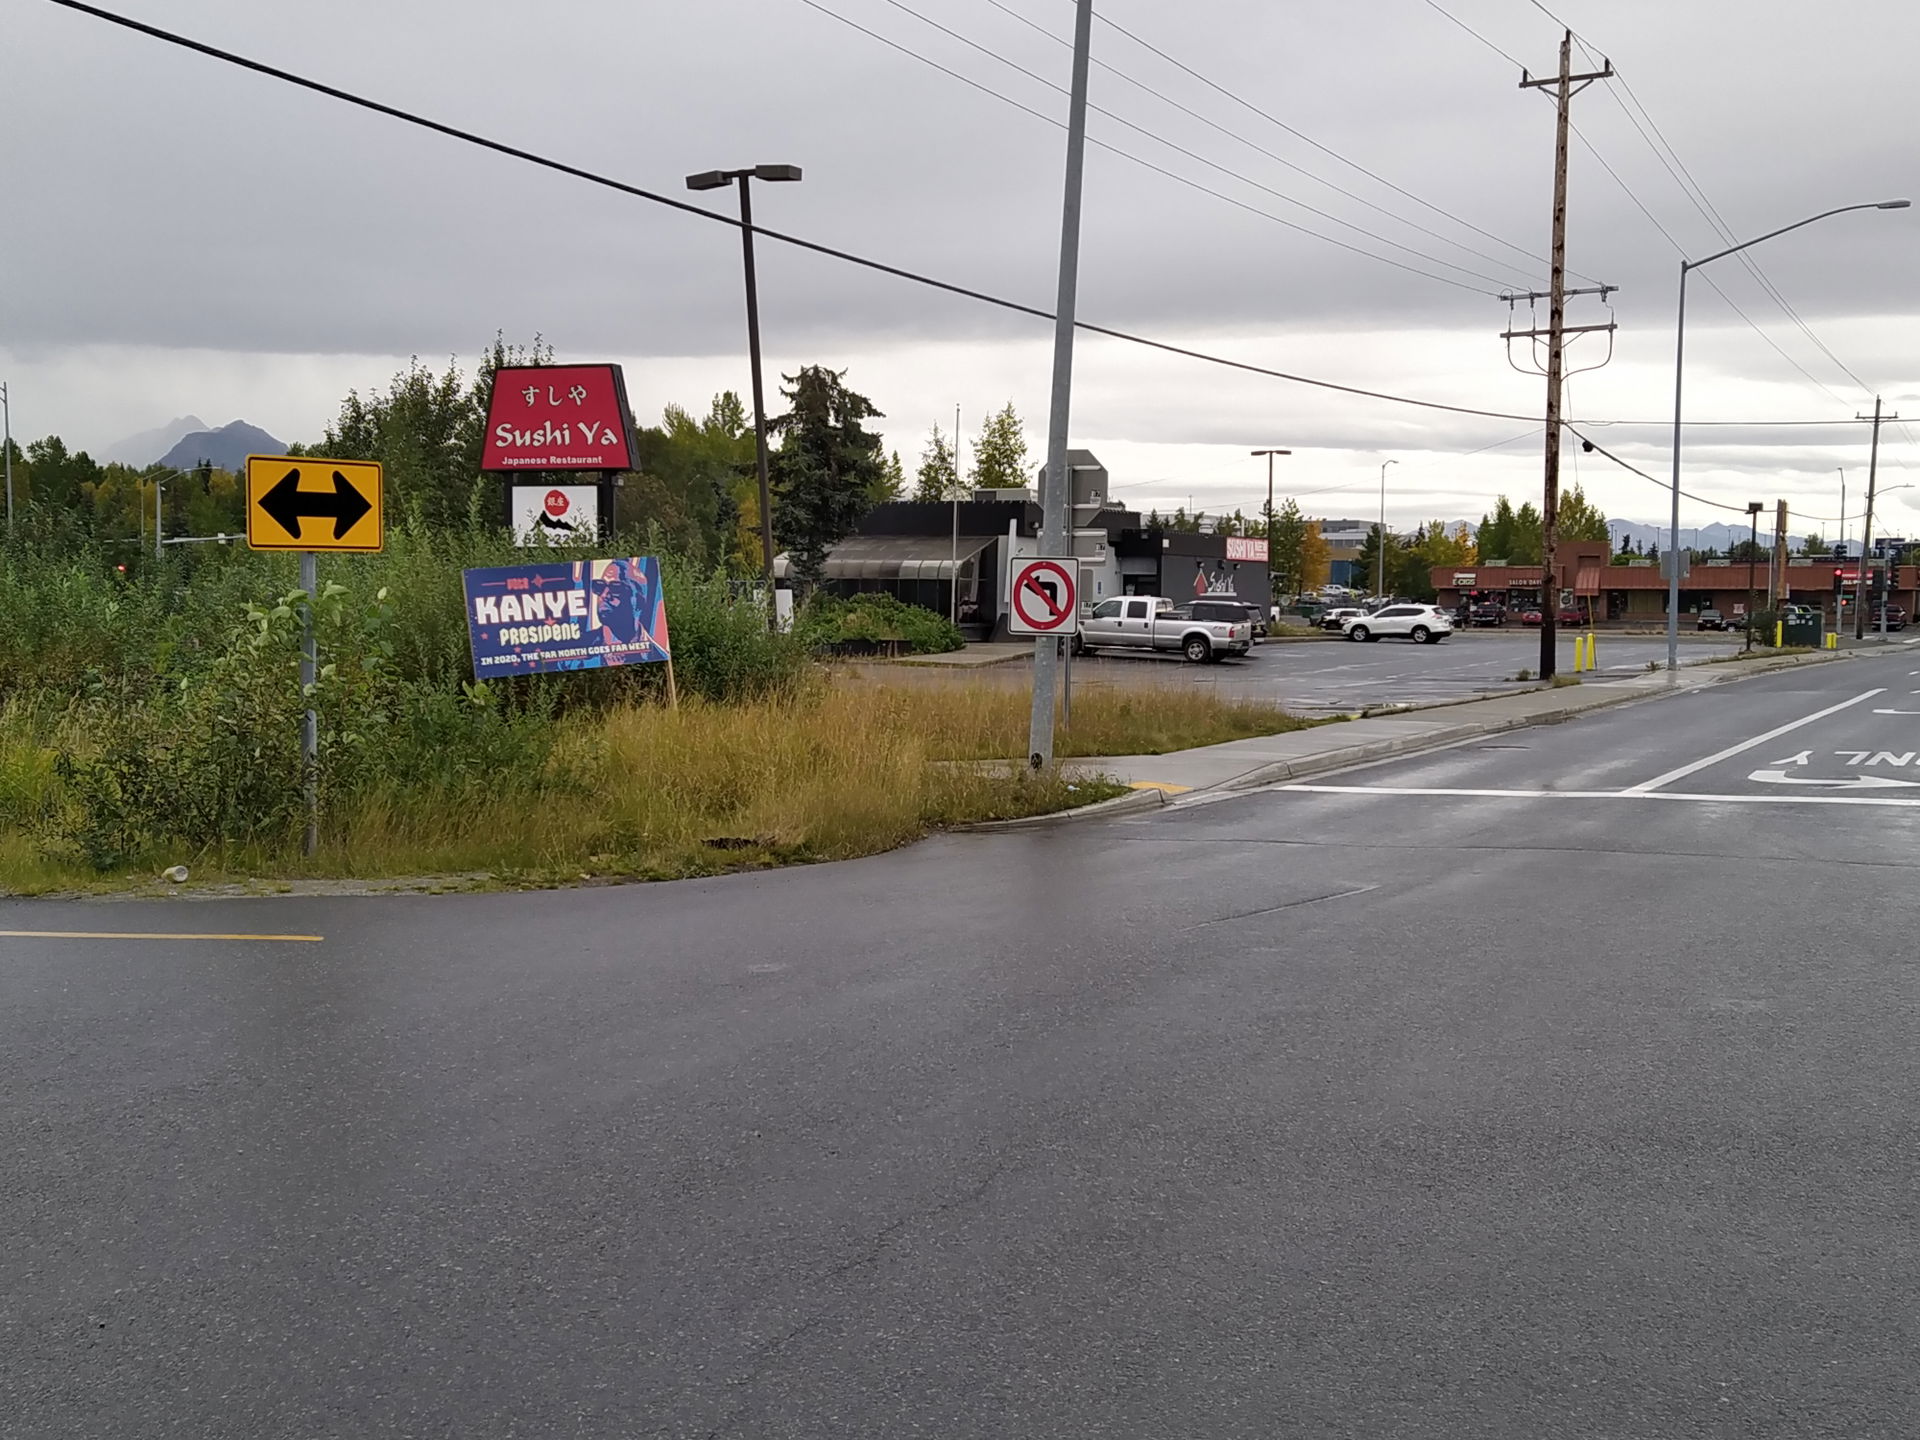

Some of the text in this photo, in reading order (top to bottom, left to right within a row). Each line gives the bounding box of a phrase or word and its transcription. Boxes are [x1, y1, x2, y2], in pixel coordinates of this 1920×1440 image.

[521, 385, 587, 407] すしや
[495, 420, 618, 447] Sushi Ya
[502, 455, 602, 466] Japanese Restaurant
[475, 590, 587, 624] KANYE
[494, 655, 520, 664] 2020,
[522, 653, 539, 661] THE
[540, 651, 557, 659] FAR
[558, 648, 587, 657] NORTH
[588, 645, 610, 655] GOES
[611, 644, 627, 653] FAR
[628, 641, 650, 651] WEST
[1769, 751, 1920, 766] NLY
